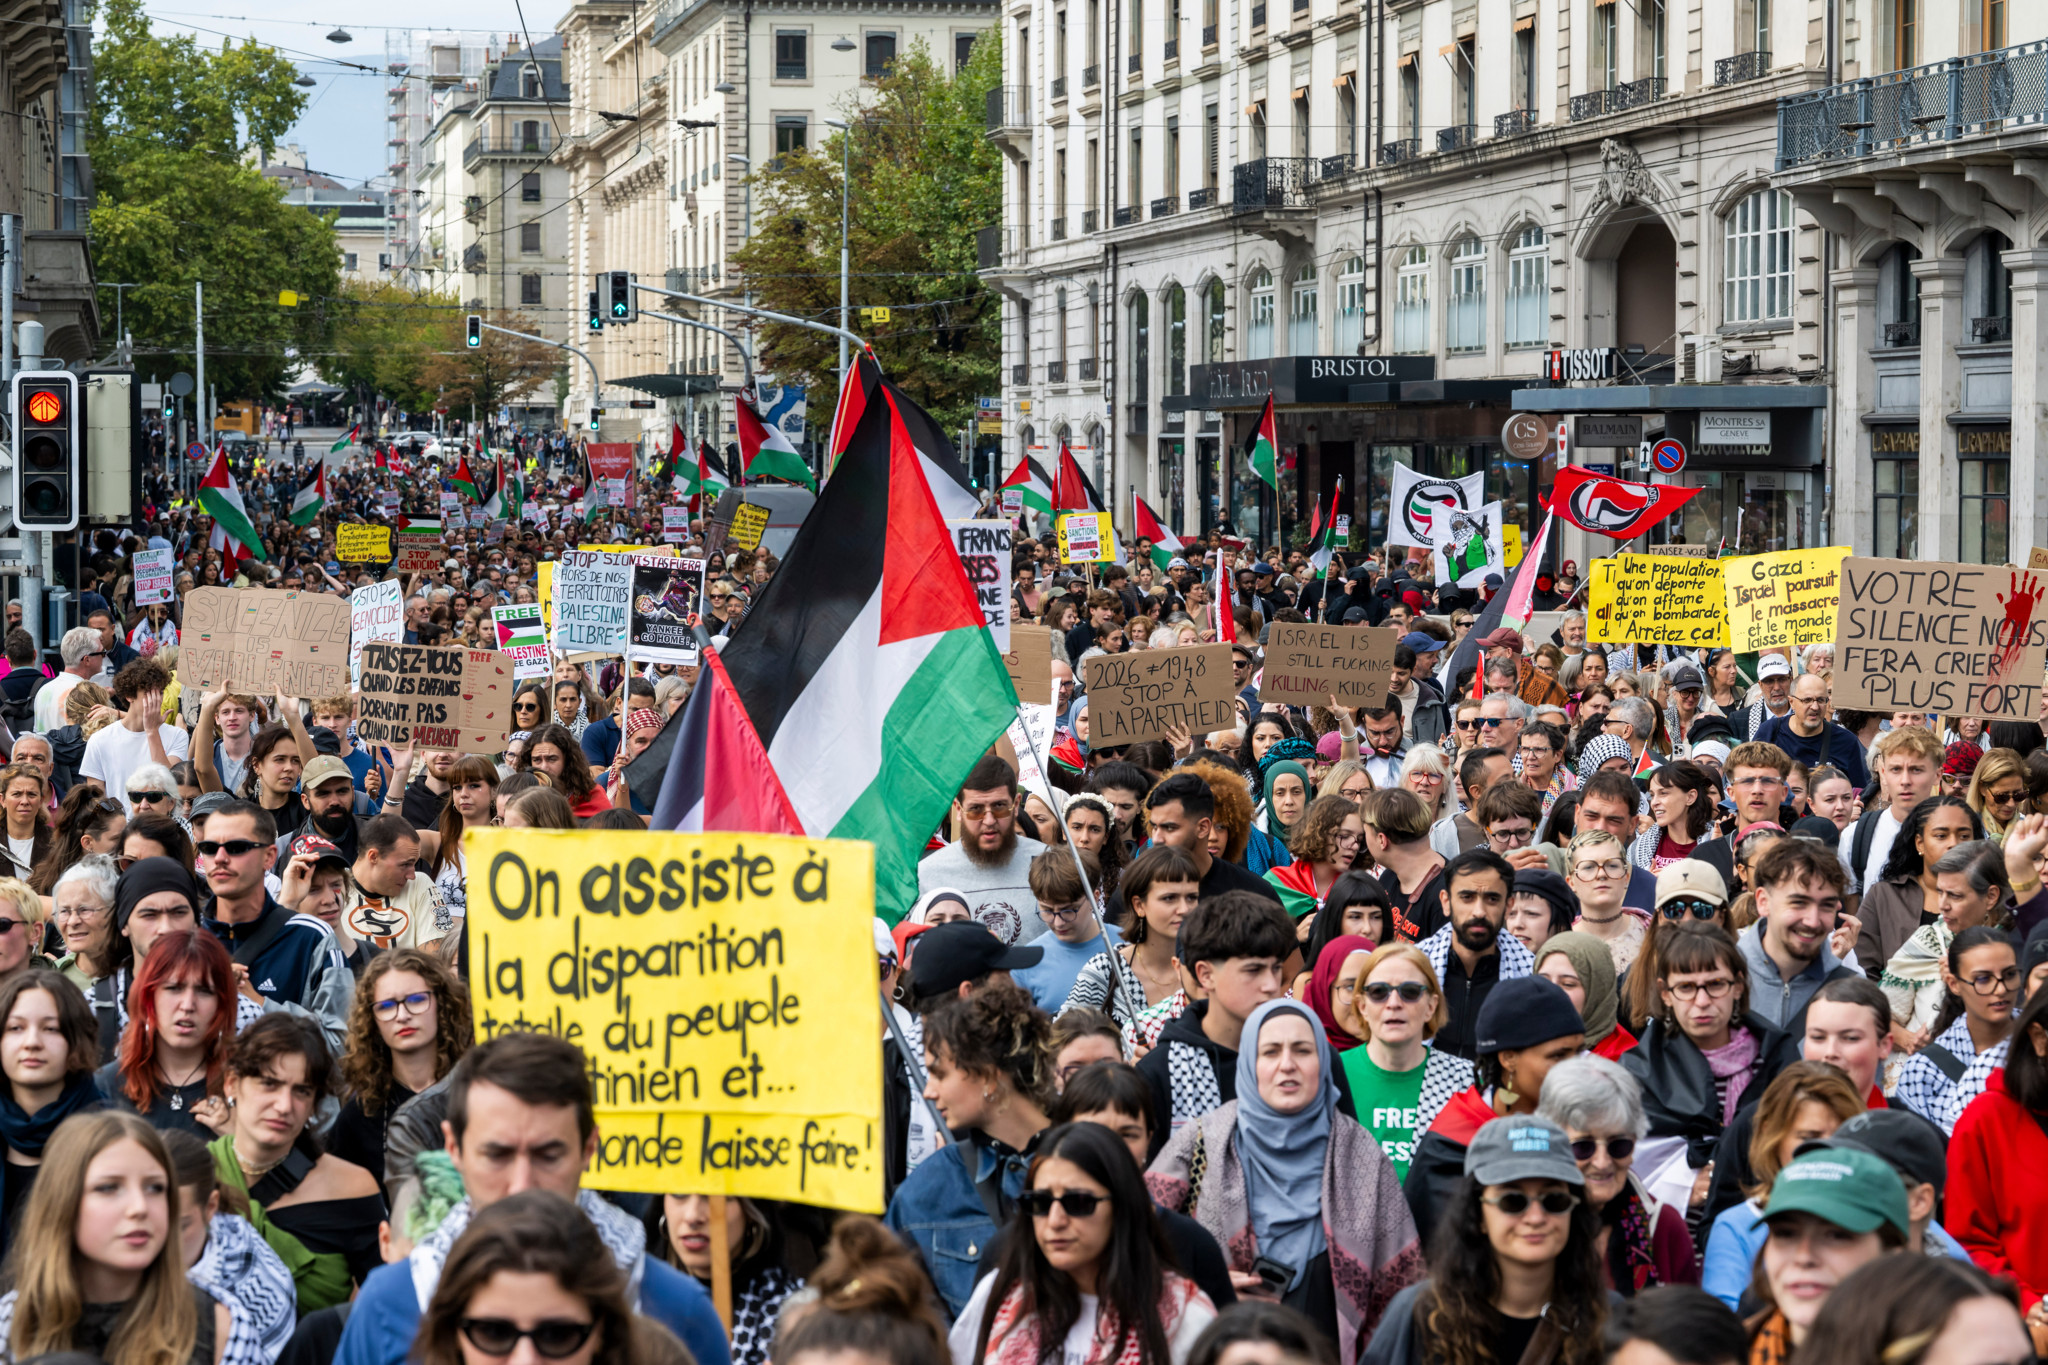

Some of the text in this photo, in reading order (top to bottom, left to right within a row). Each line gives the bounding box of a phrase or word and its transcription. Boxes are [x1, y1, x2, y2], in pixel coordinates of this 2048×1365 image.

[1311, 359, 1395, 378] BRISTOL
[1561, 347, 1609, 381] TISSOT
[1513, 420, 1538, 439] CS
[1583, 424, 1637, 435] BALMAIN
[1704, 416, 1753, 426] MONTRES
[957, 526, 1011, 553] FRANCS
[1068, 526, 1097, 537] SANCTIONS
[408, 550, 430, 559] STOP
[562, 551, 599, 568] STOP
[1650, 547, 1707, 556] TAISEZ-VOUS
[2034, 553, 2048, 563] GA
[135, 562, 160, 570] GENOCIDE
[135, 566, 166, 574] OCCUPATION
[135, 570, 171, 579] COLONISATION
[399, 559, 440, 570] GENOCIDE
[1624, 557, 1647, 575] Une
[1751, 560, 1802, 581] Gaza
[137, 577, 171, 590] STOP ISRAEL
[560, 569, 626, 584] HORS DE NOS
[1617, 573, 1706, 597] qu'on déporte
[359, 583, 389, 606] STOP
[559, 584, 630, 602] TERRITOIRES
[1733, 578, 1776, 607] Israël
[1785, 570, 1838, 603] poursuit
[1848, 569, 1985, 609] VOTRE
[494, 606, 540, 620] FREE
[559, 602, 626, 625] PALESTINA
[1616, 594, 1704, 612] qu'on affame
[1751, 596, 1840, 622] le massacre
[188, 589, 352, 643] SILENCE
[352, 603, 400, 632] GENOCIDE
[1614, 603, 1720, 627] qu'on bombarde
[1767, 619, 1778, 633] le
[1785, 610, 1832, 630] monde
[367, 626, 378, 639] LA
[569, 623, 615, 645] LIBRE
[646, 623, 684, 635] YANKEE
[1625, 619, 1686, 642] Arrêtez
[1847, 607, 2047, 648] SILENCE NOUS
[247, 636, 270, 654] IS
[640, 632, 656, 642] GO
[656, 634, 685, 645] HOME
[1276, 629, 1370, 650] ISRAEL IS
[1747, 632, 1787, 651] laisse
[362, 645, 463, 676] TAISEZ-VOUS
[500, 644, 548, 660] PALESTINE
[526, 657, 548, 666] GAZA
[1287, 653, 1391, 672] STILL FUCKING
[1843, 646, 2002, 676] FERA CRIER
[360, 671, 392, 693] QUAND
[393, 676, 416, 695] LES
[417, 677, 461, 697] ENFANTS
[1092, 658, 1140, 691] 2026
[1121, 677, 1198, 706] STOP À
[1271, 674, 1376, 698] KILLING KIDS
[1861, 673, 2042, 717] PLUS FORT
[416, 702, 448, 724] PAS
[1029, 711, 1041, 725] UNE
[358, 718, 461, 748] QUAND ILS MEURENT
[1032, 727, 1045, 740] POUR
[489, 843, 829, 921] On assiste à
[481, 915, 785, 1015] la disparition
[603, 994, 653, 1054] du
[663, 974, 800, 1069] peuple
[590, 1056, 699, 1106] tinien
[1373, 1107, 1417, 1129] FRE
[700, 1113, 790, 1176] laisse
